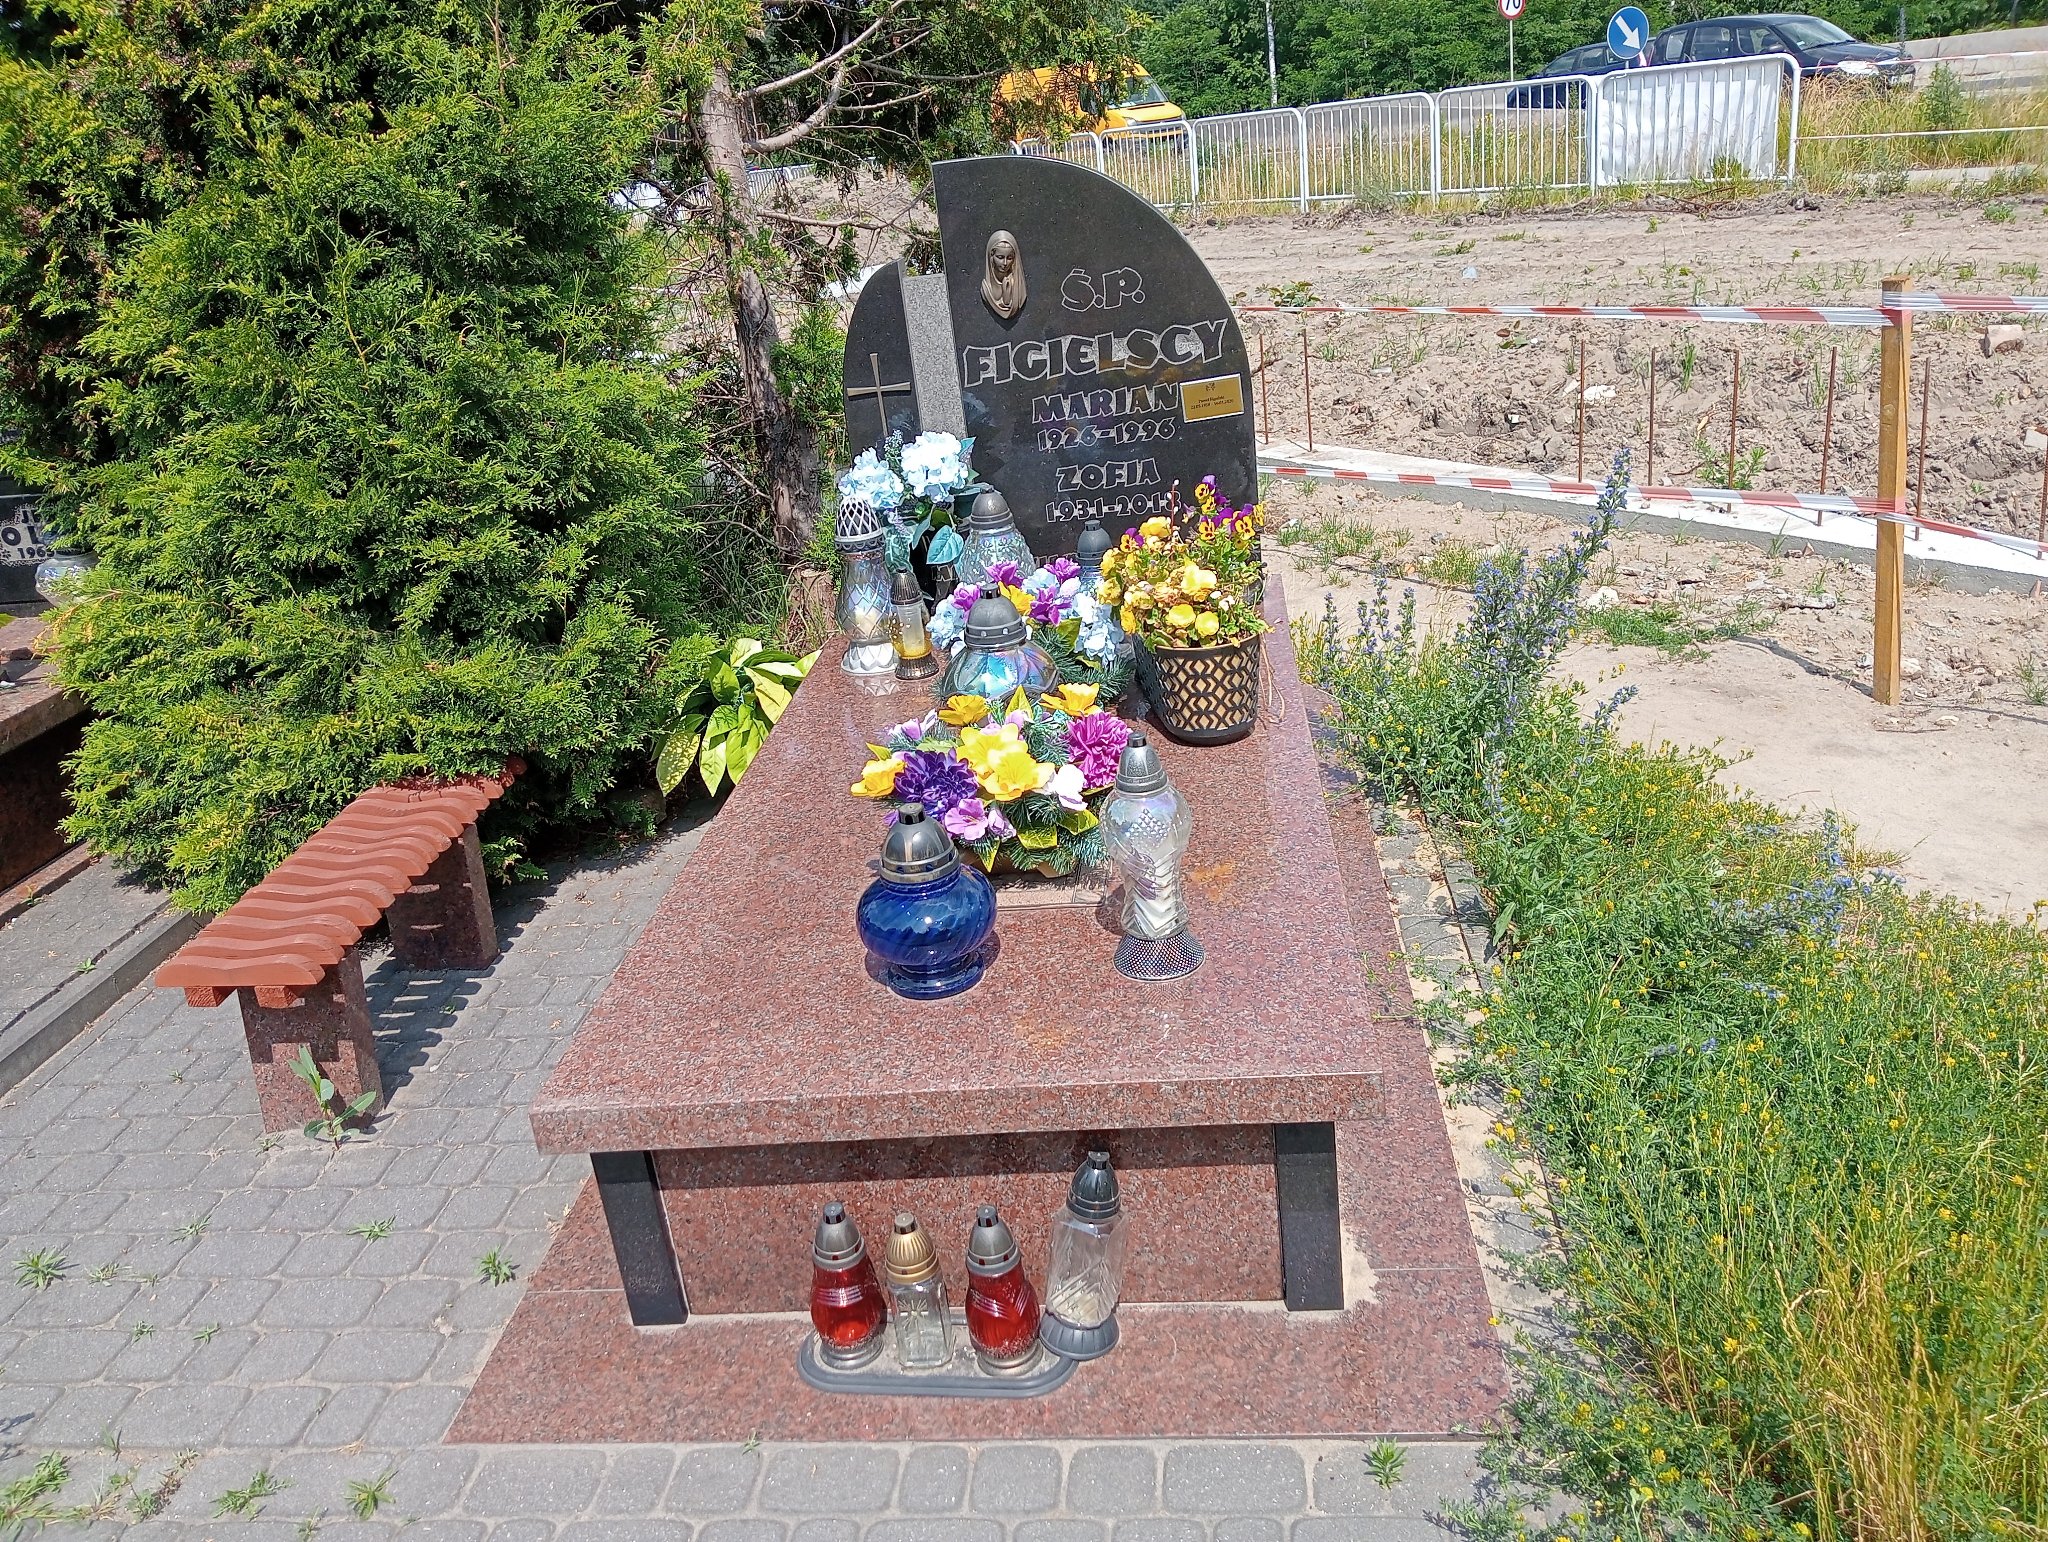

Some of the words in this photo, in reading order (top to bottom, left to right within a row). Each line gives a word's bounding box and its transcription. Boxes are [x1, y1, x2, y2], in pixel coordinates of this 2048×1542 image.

[963, 318, 1229, 388] FIGIELSCY
[1031, 382, 1179, 424] MARIAN
[1037, 417, 1176, 452] 1926-1996
[1055, 458, 1161, 492] ZOFIA
